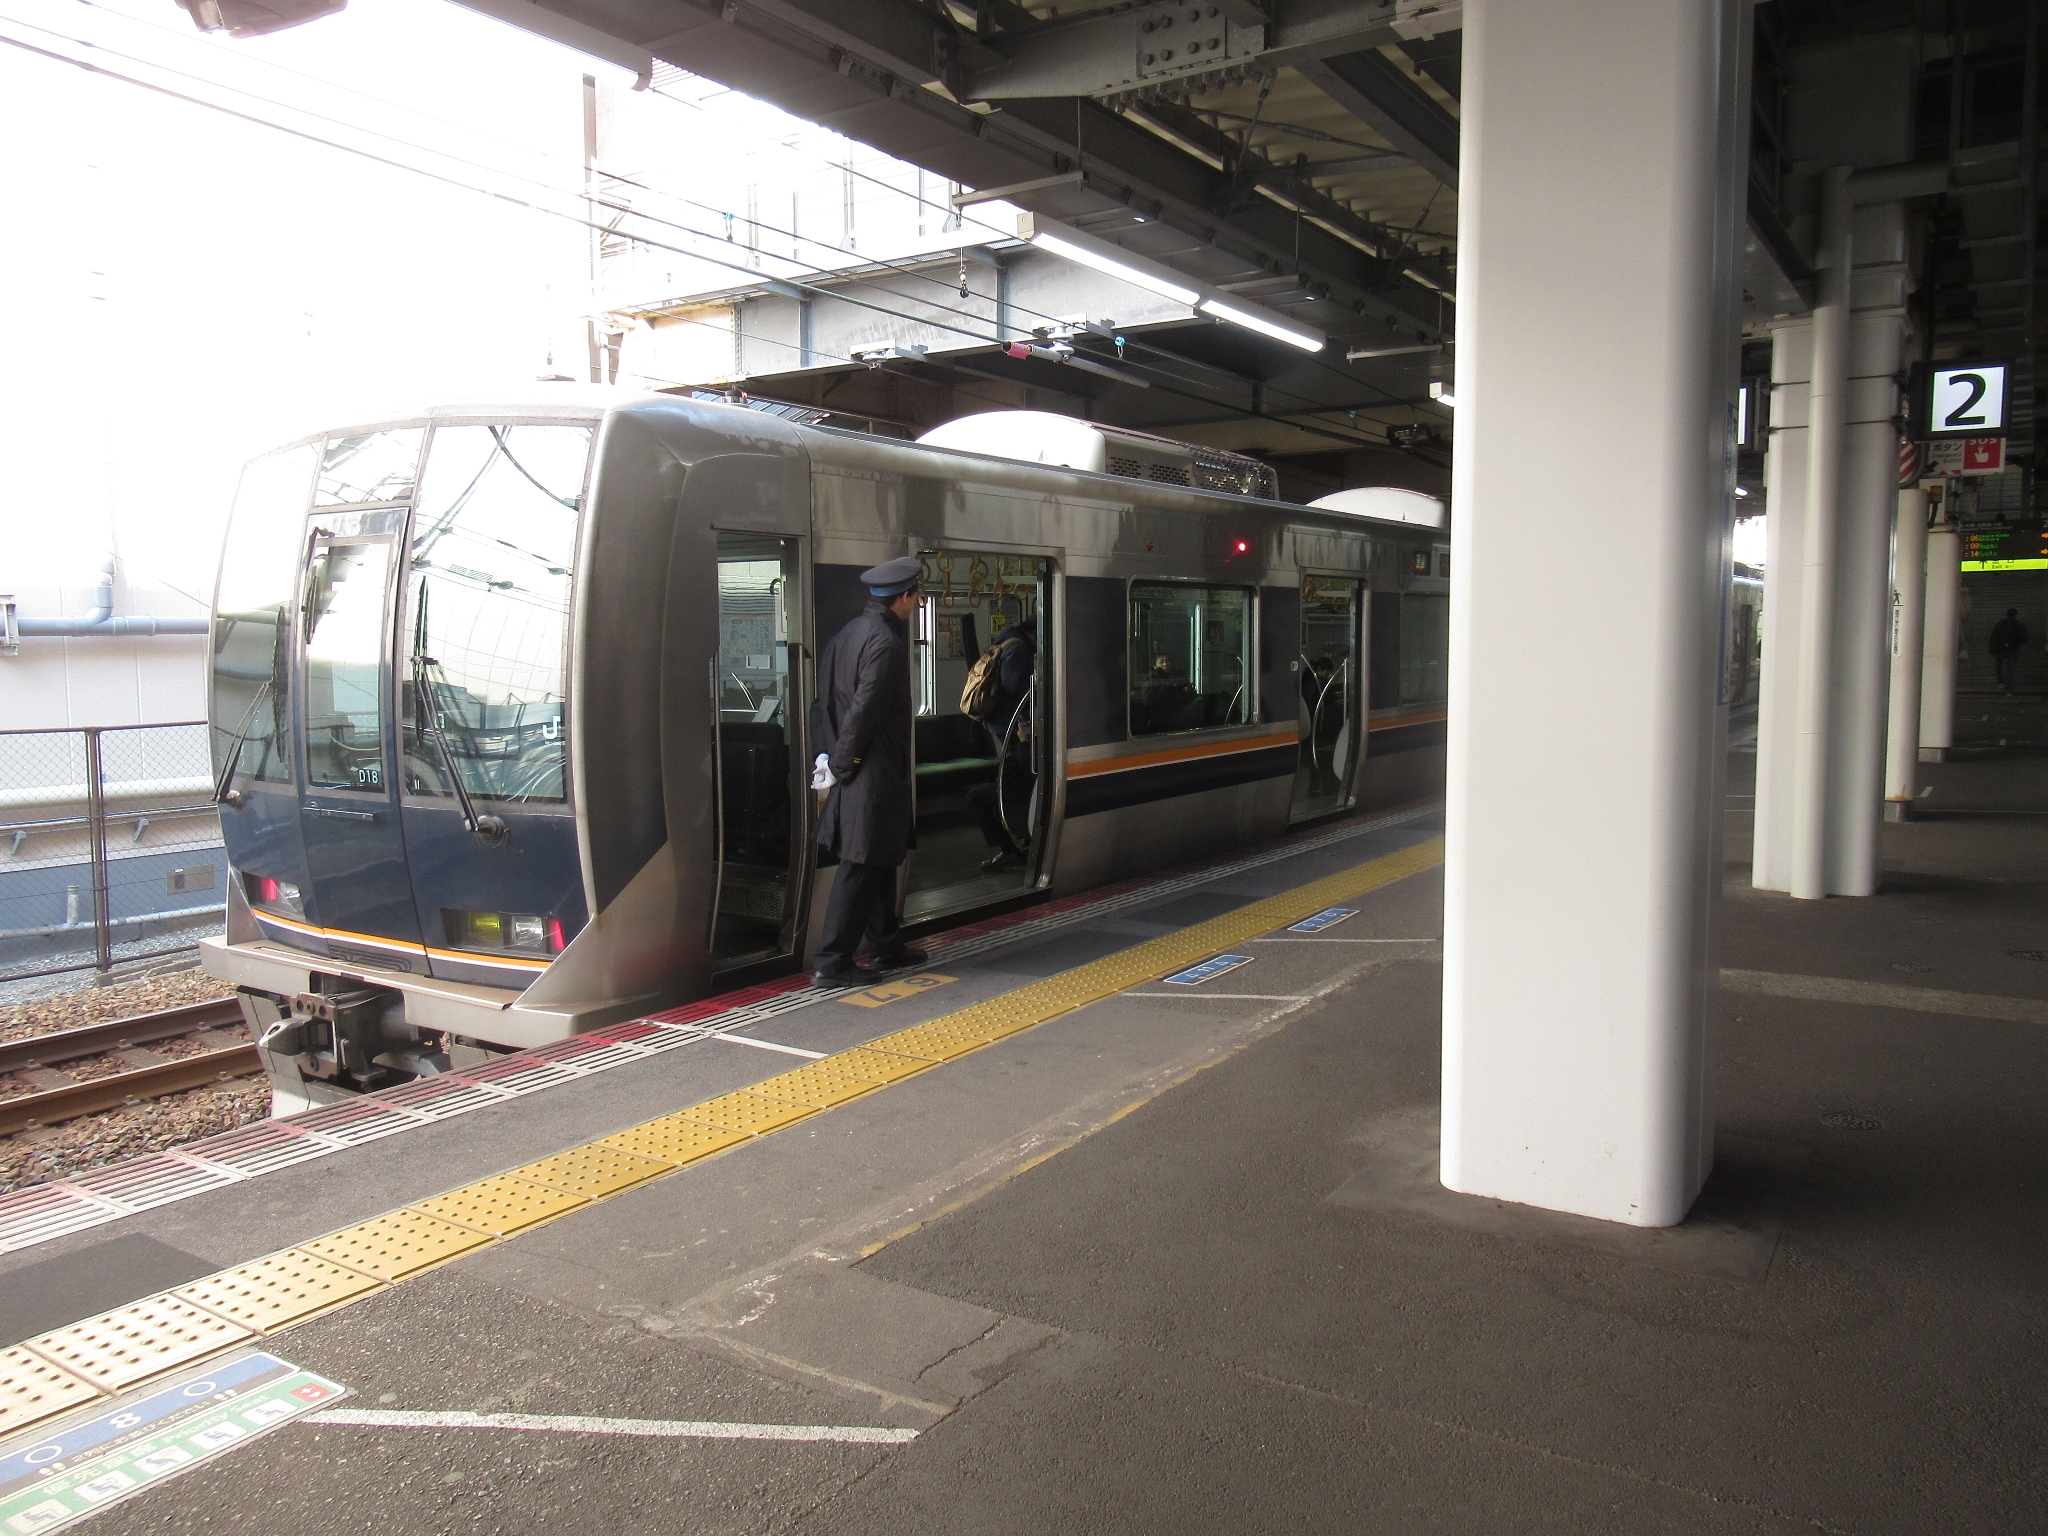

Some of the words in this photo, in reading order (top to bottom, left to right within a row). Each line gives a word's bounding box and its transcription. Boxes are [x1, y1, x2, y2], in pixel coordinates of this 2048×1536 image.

[1944, 373, 1987, 427] 2
[1933, 443, 1962, 452] ボタン
[358, 769, 379, 784] D18
[109, 1412, 143, 1429] 8
[163, 1412, 229, 1444] Priority
[230, 1394, 271, 1413] Seat
